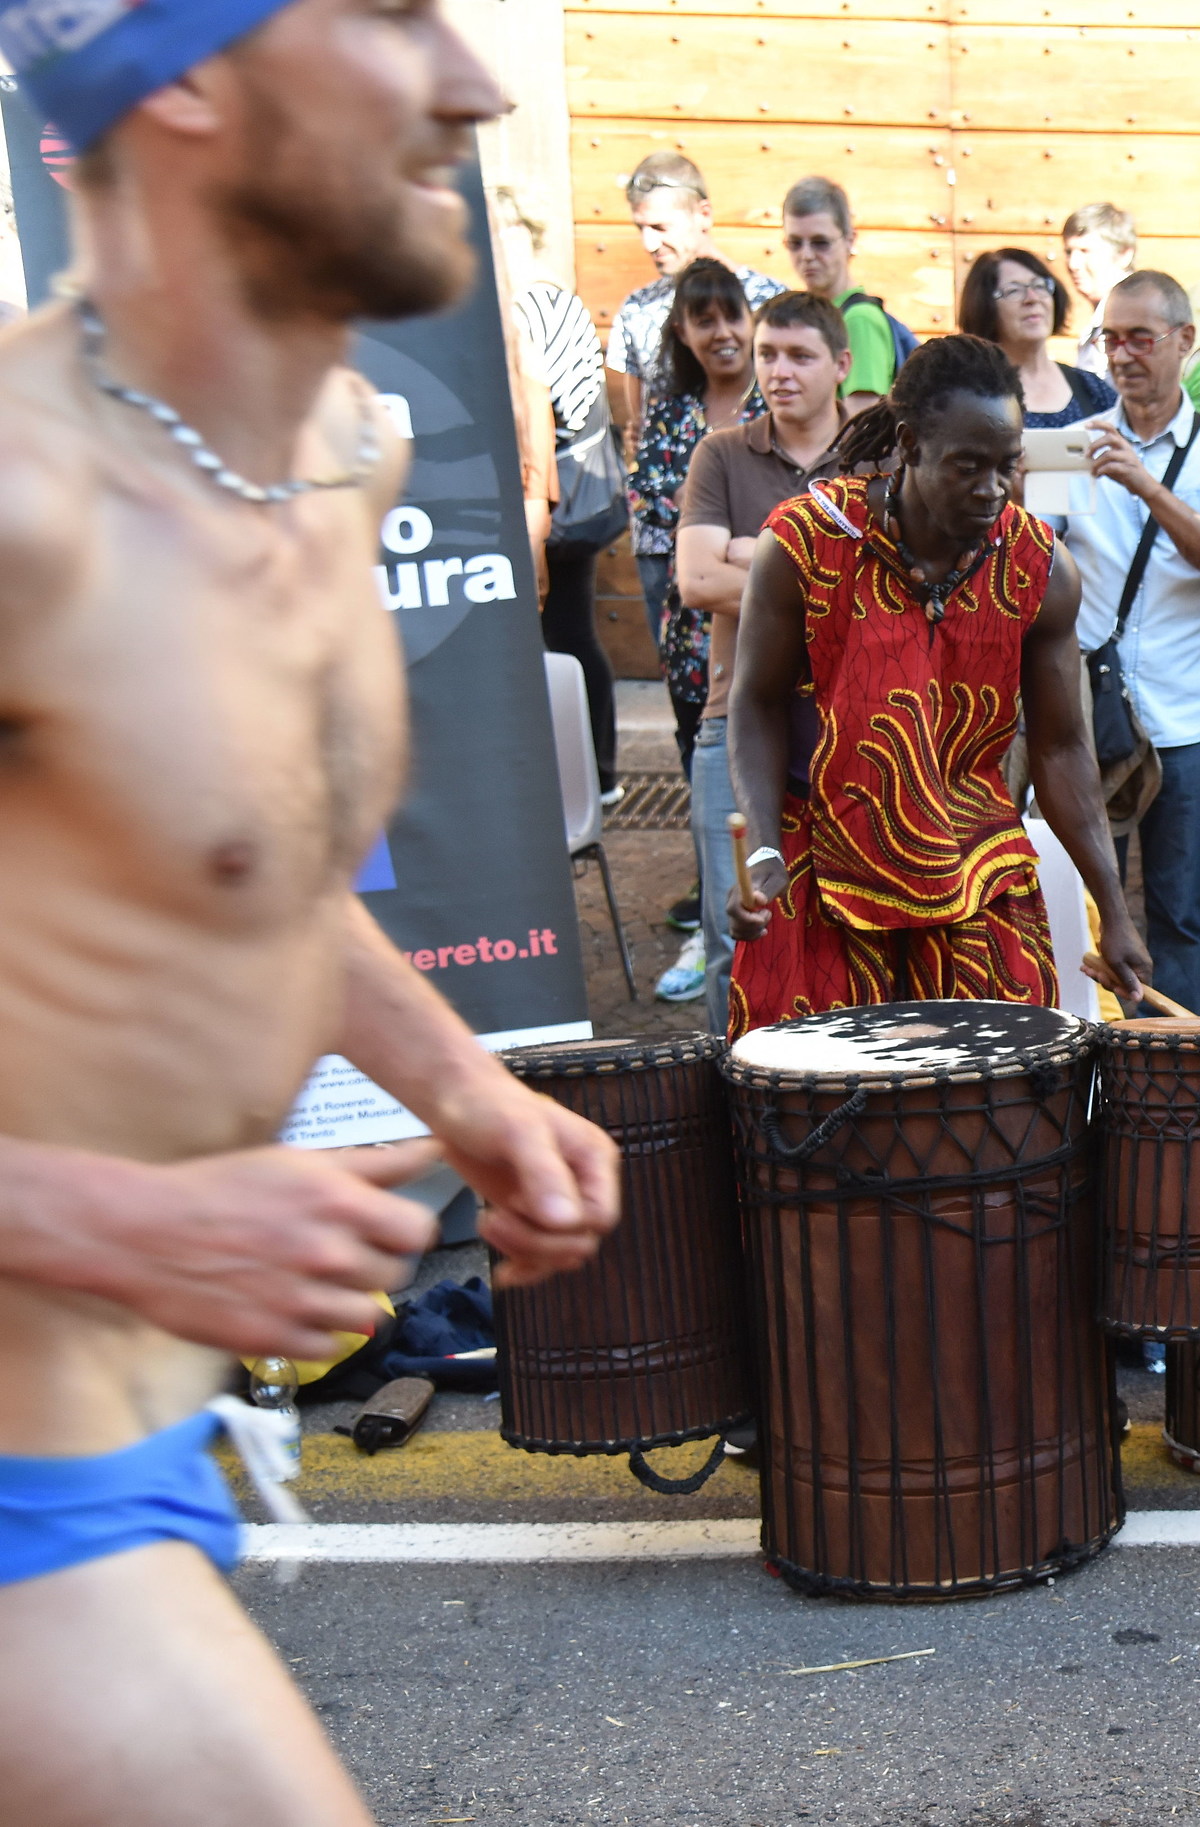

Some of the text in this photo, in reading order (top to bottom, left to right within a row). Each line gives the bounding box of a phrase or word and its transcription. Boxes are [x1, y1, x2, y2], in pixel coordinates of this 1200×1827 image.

[371, 552, 518, 611] ura
[325, 1097, 376, 1110] Rovereto
[316, 1112, 354, 1126] Scuole
[300, 1128, 336, 1140] Trento
